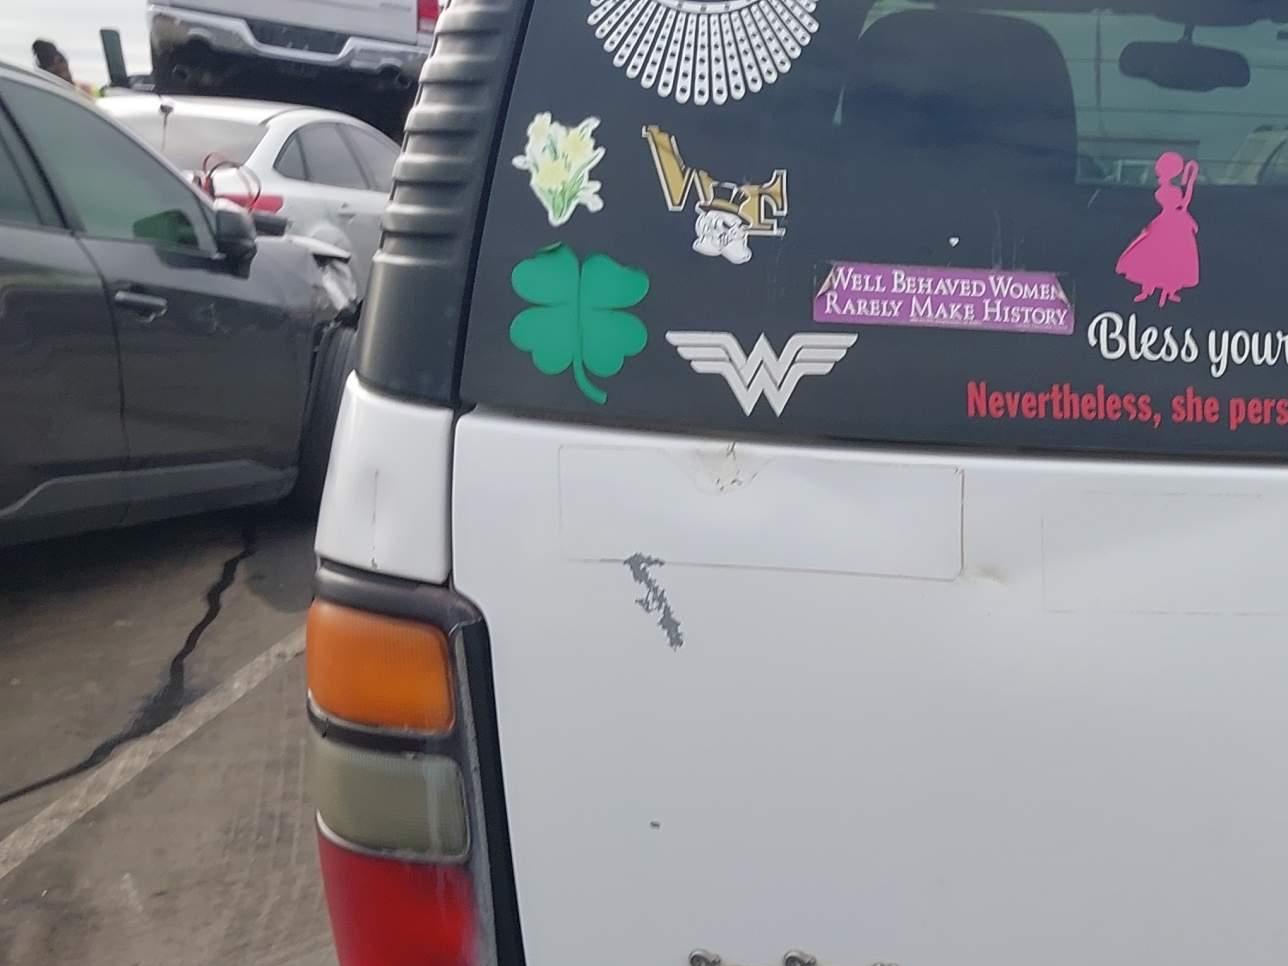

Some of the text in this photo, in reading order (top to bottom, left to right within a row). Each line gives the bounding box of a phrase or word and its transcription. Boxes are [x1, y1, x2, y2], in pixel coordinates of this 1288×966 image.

[831, 266, 886, 293] WELL
[891, 269, 986, 297] BEHAVED
[824, 291, 1069, 326] RARELY MAKE HISTORY
[1087, 311, 1199, 363] Bless
[966, 382, 1162, 429] Nevertheless,
[1171, 387, 1219, 423] she
